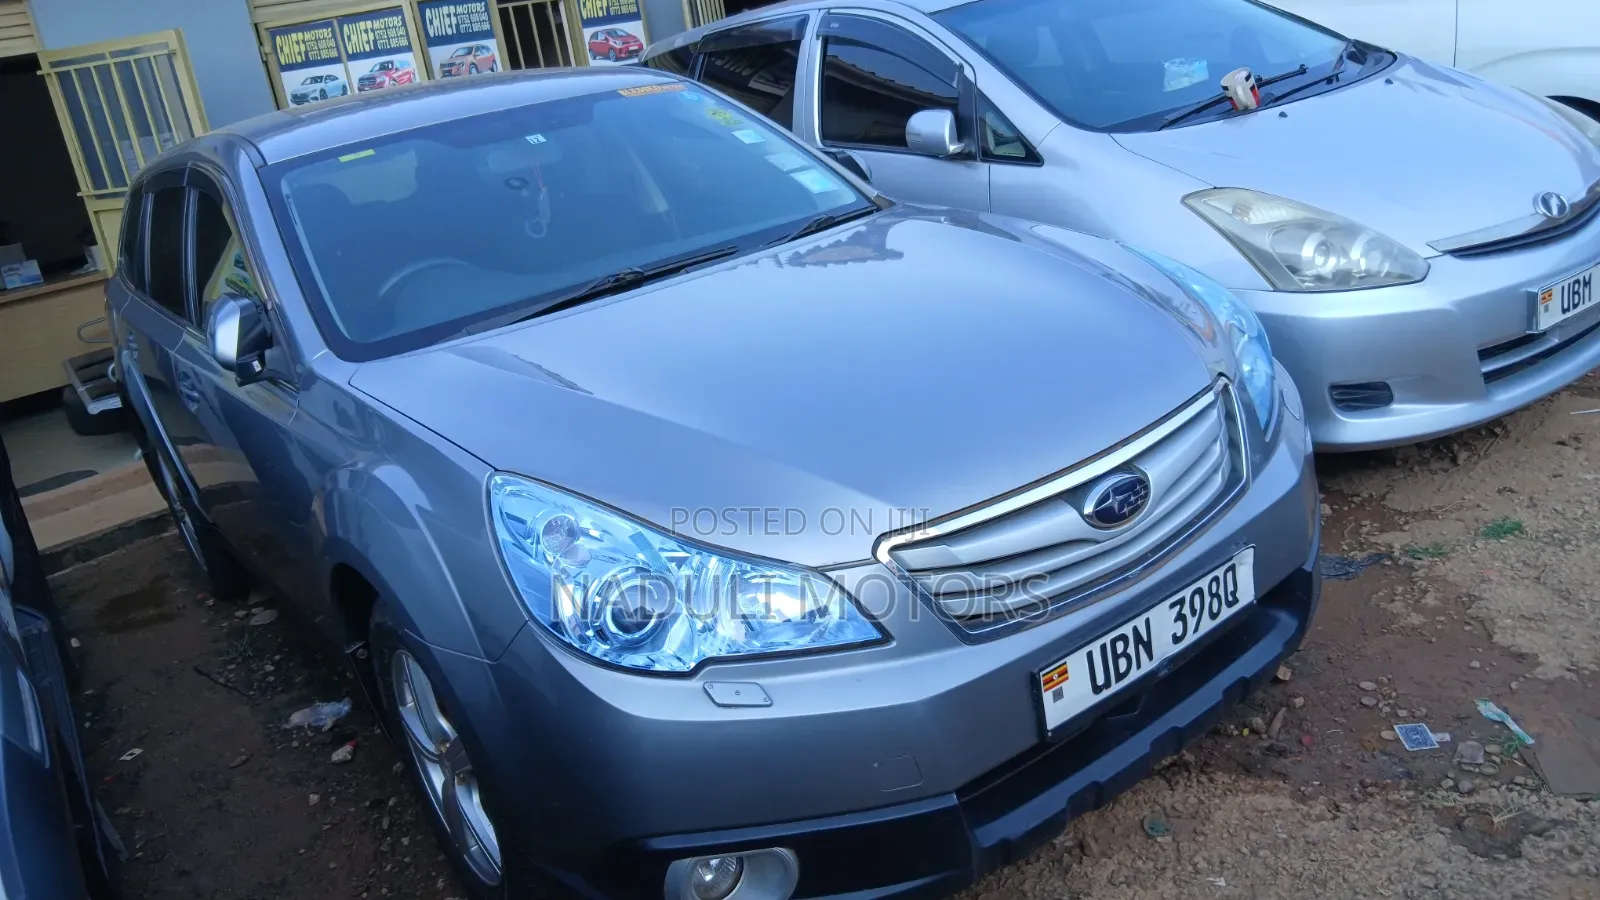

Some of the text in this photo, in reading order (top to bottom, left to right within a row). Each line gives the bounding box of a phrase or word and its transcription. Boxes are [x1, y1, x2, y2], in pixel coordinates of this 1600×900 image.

[343, 16, 402, 54] CHIEF MOTORS
[426, 2, 485, 37] CHIEF MOTORS
[276, 28, 332, 65] CHIEF MOTORS
[1561, 272, 1592, 314] UBM
[1086, 562, 1240, 695] UBN 398Q
